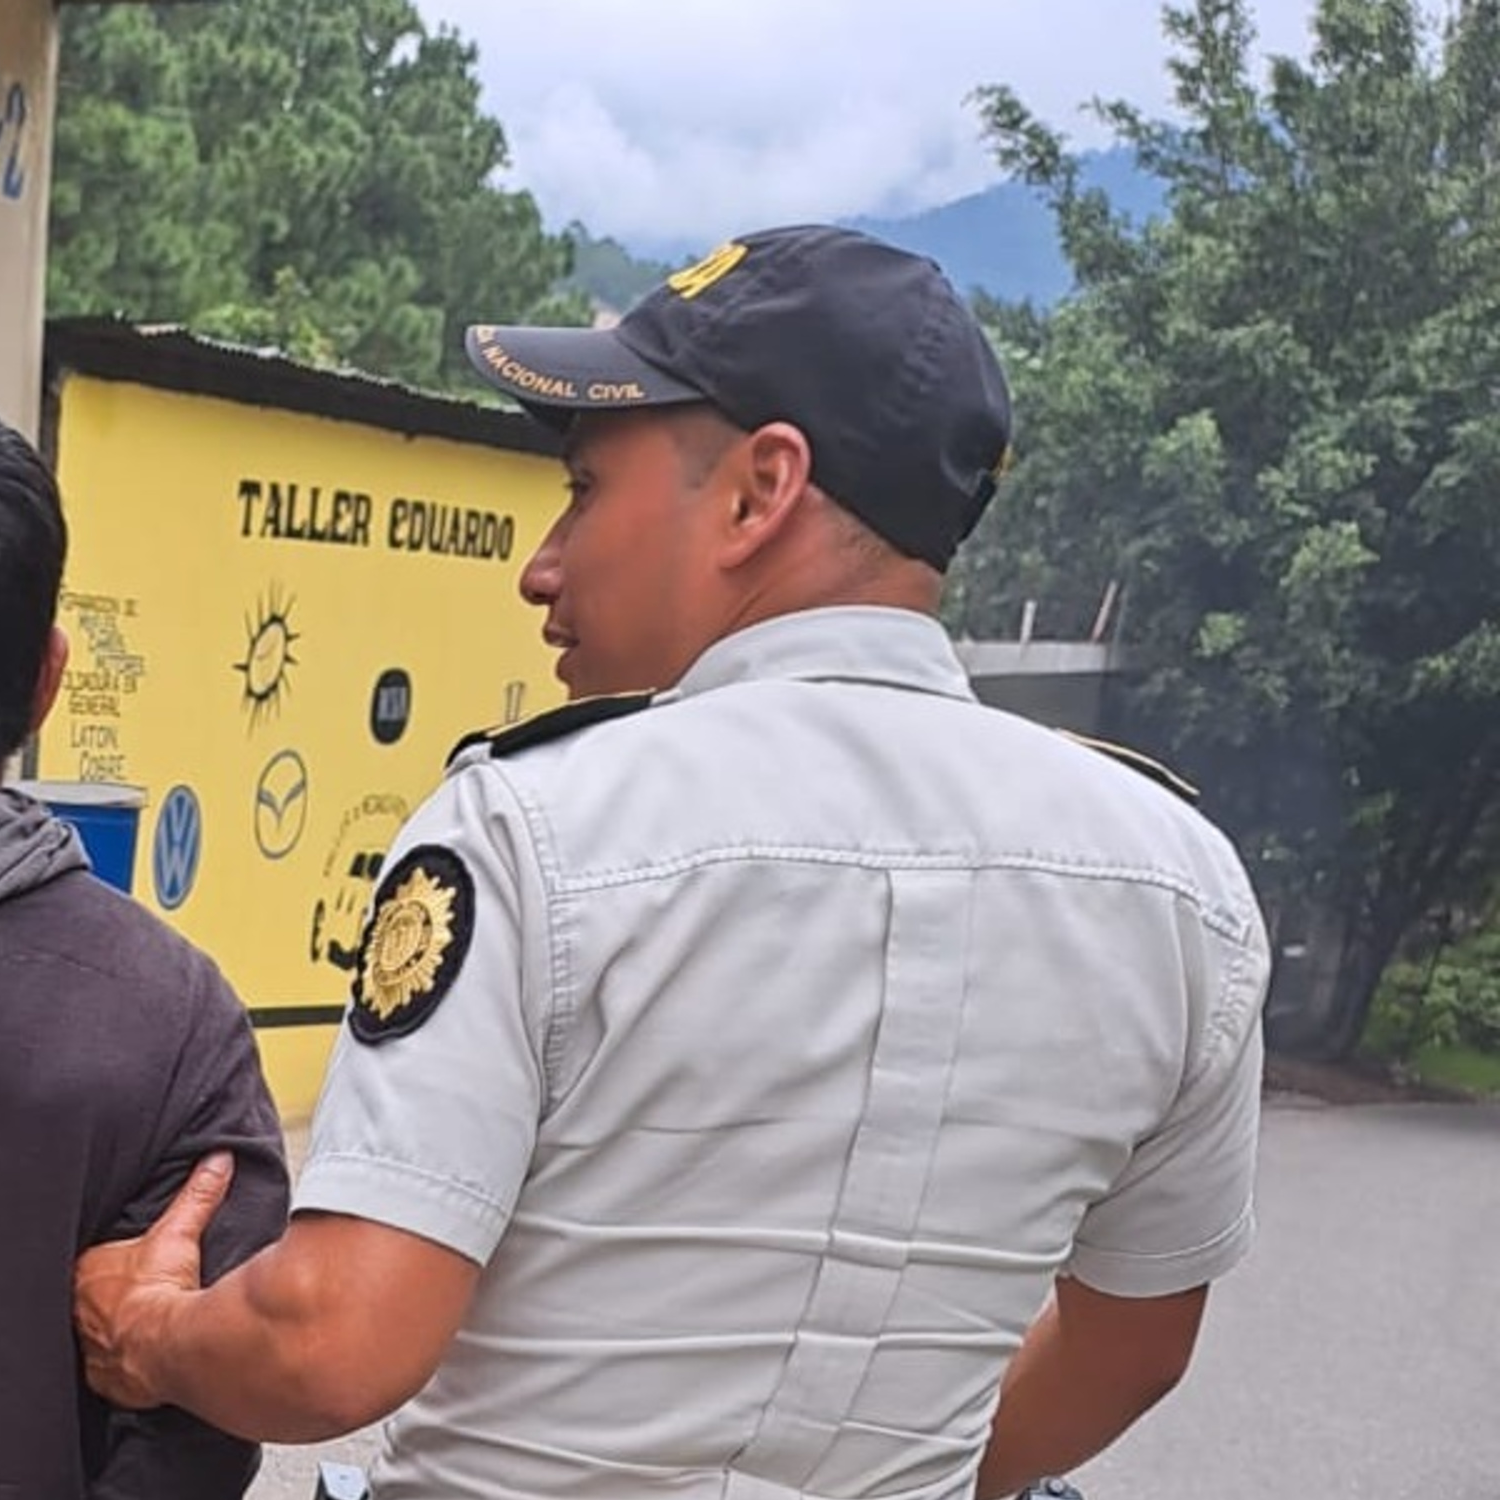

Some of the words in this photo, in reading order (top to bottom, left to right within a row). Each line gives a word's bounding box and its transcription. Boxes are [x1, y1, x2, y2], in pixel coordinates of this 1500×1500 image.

[481, 345, 578, 398] NACIONAL
[587, 382, 646, 400] CIVIL
[238, 480, 372, 547] TALLER
